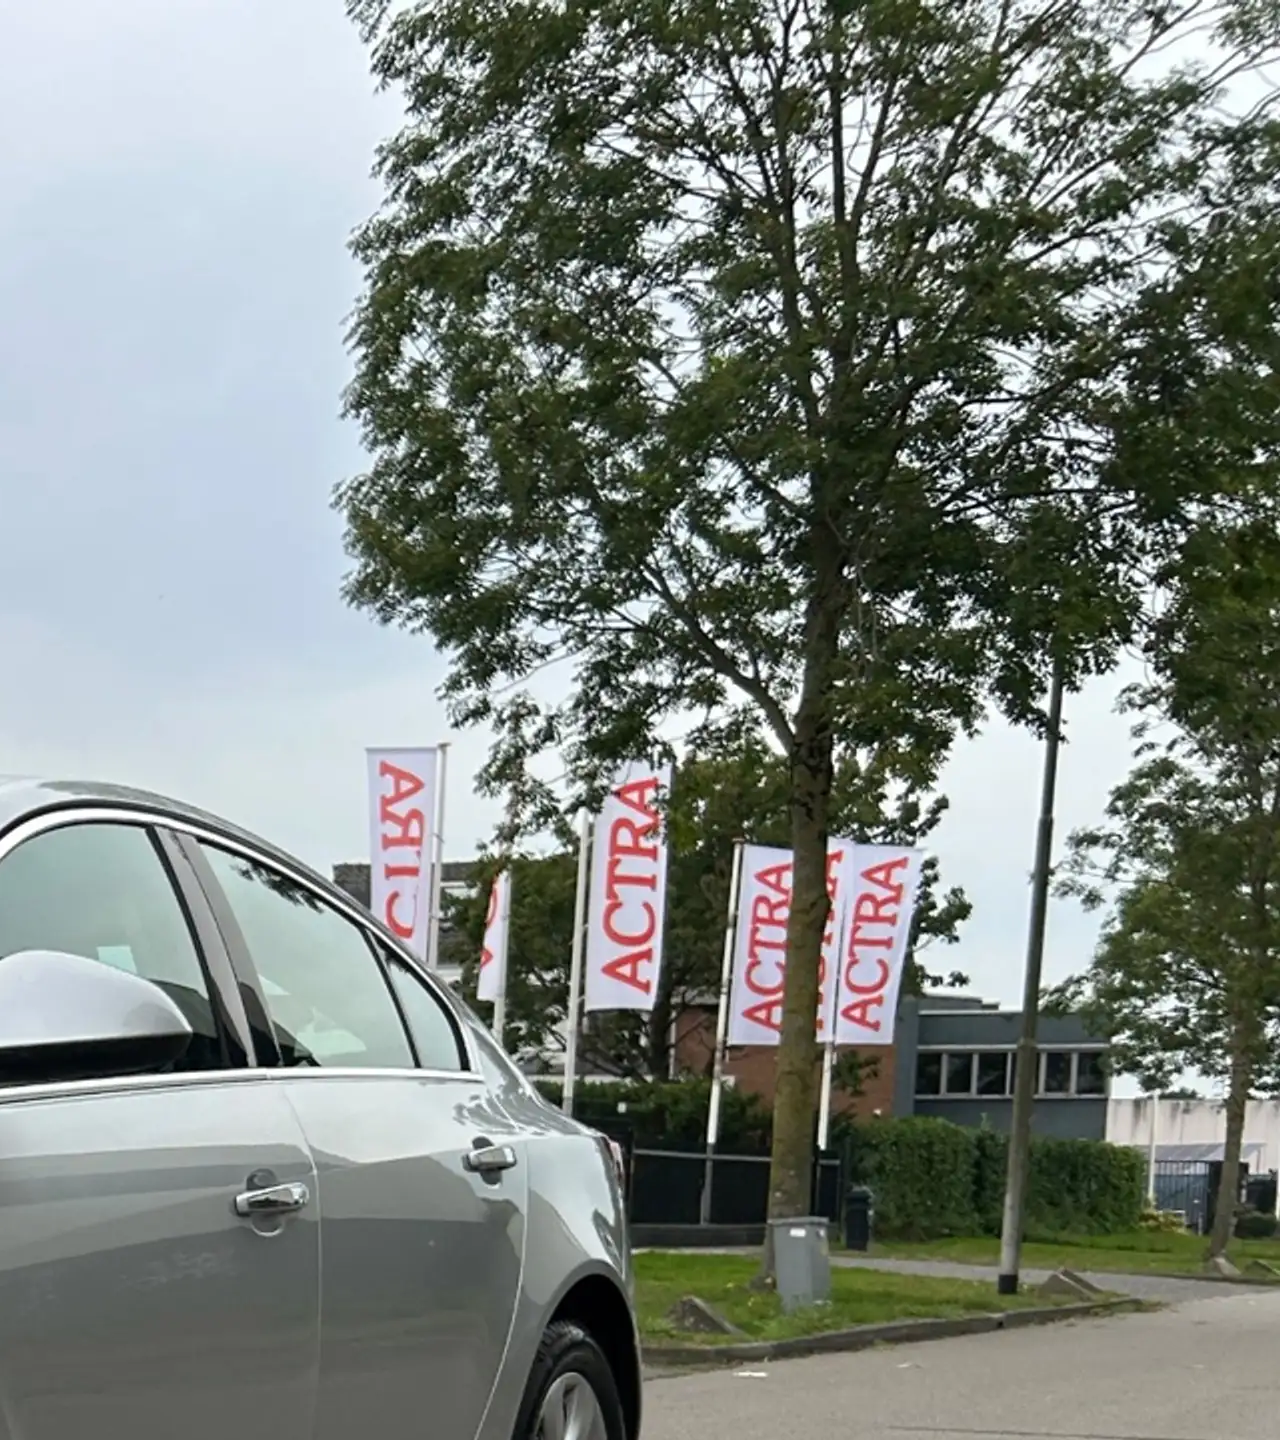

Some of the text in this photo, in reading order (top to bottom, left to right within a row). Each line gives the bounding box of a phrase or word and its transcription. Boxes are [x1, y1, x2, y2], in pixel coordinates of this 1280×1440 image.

[601, 776, 660, 995] ACTRA
[741, 862, 794, 1033] ACTRA
[840, 856, 910, 1033] ACTRA
